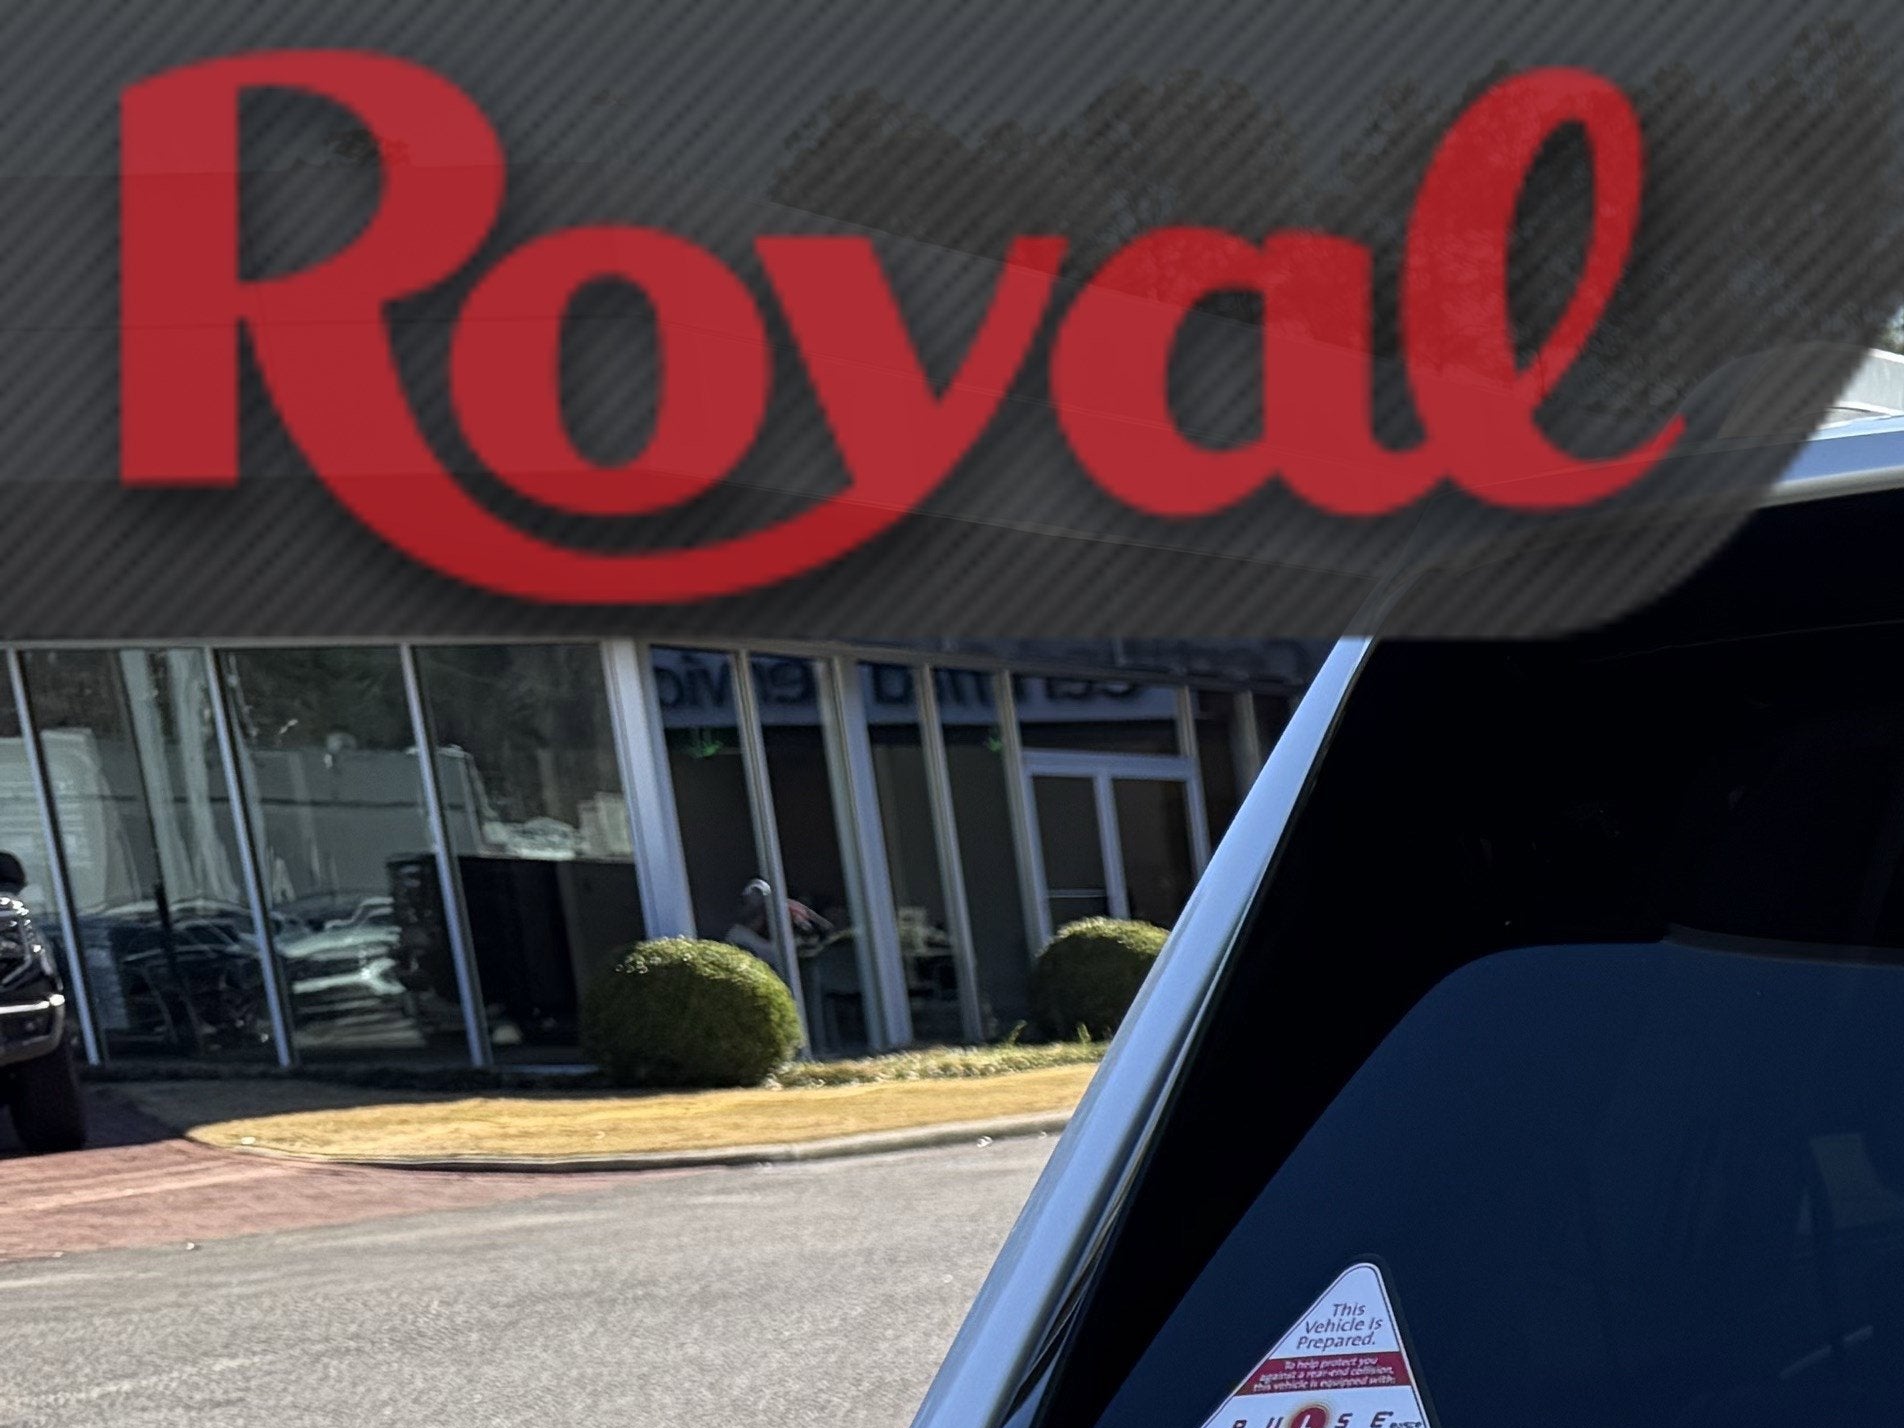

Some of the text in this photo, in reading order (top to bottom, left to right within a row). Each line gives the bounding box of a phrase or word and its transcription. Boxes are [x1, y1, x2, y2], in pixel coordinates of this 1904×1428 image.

[1333, 1302, 1366, 1317] This
[1305, 1318, 1364, 1334] Vehicle
[1296, 1332, 1375, 1351] Prepared.
